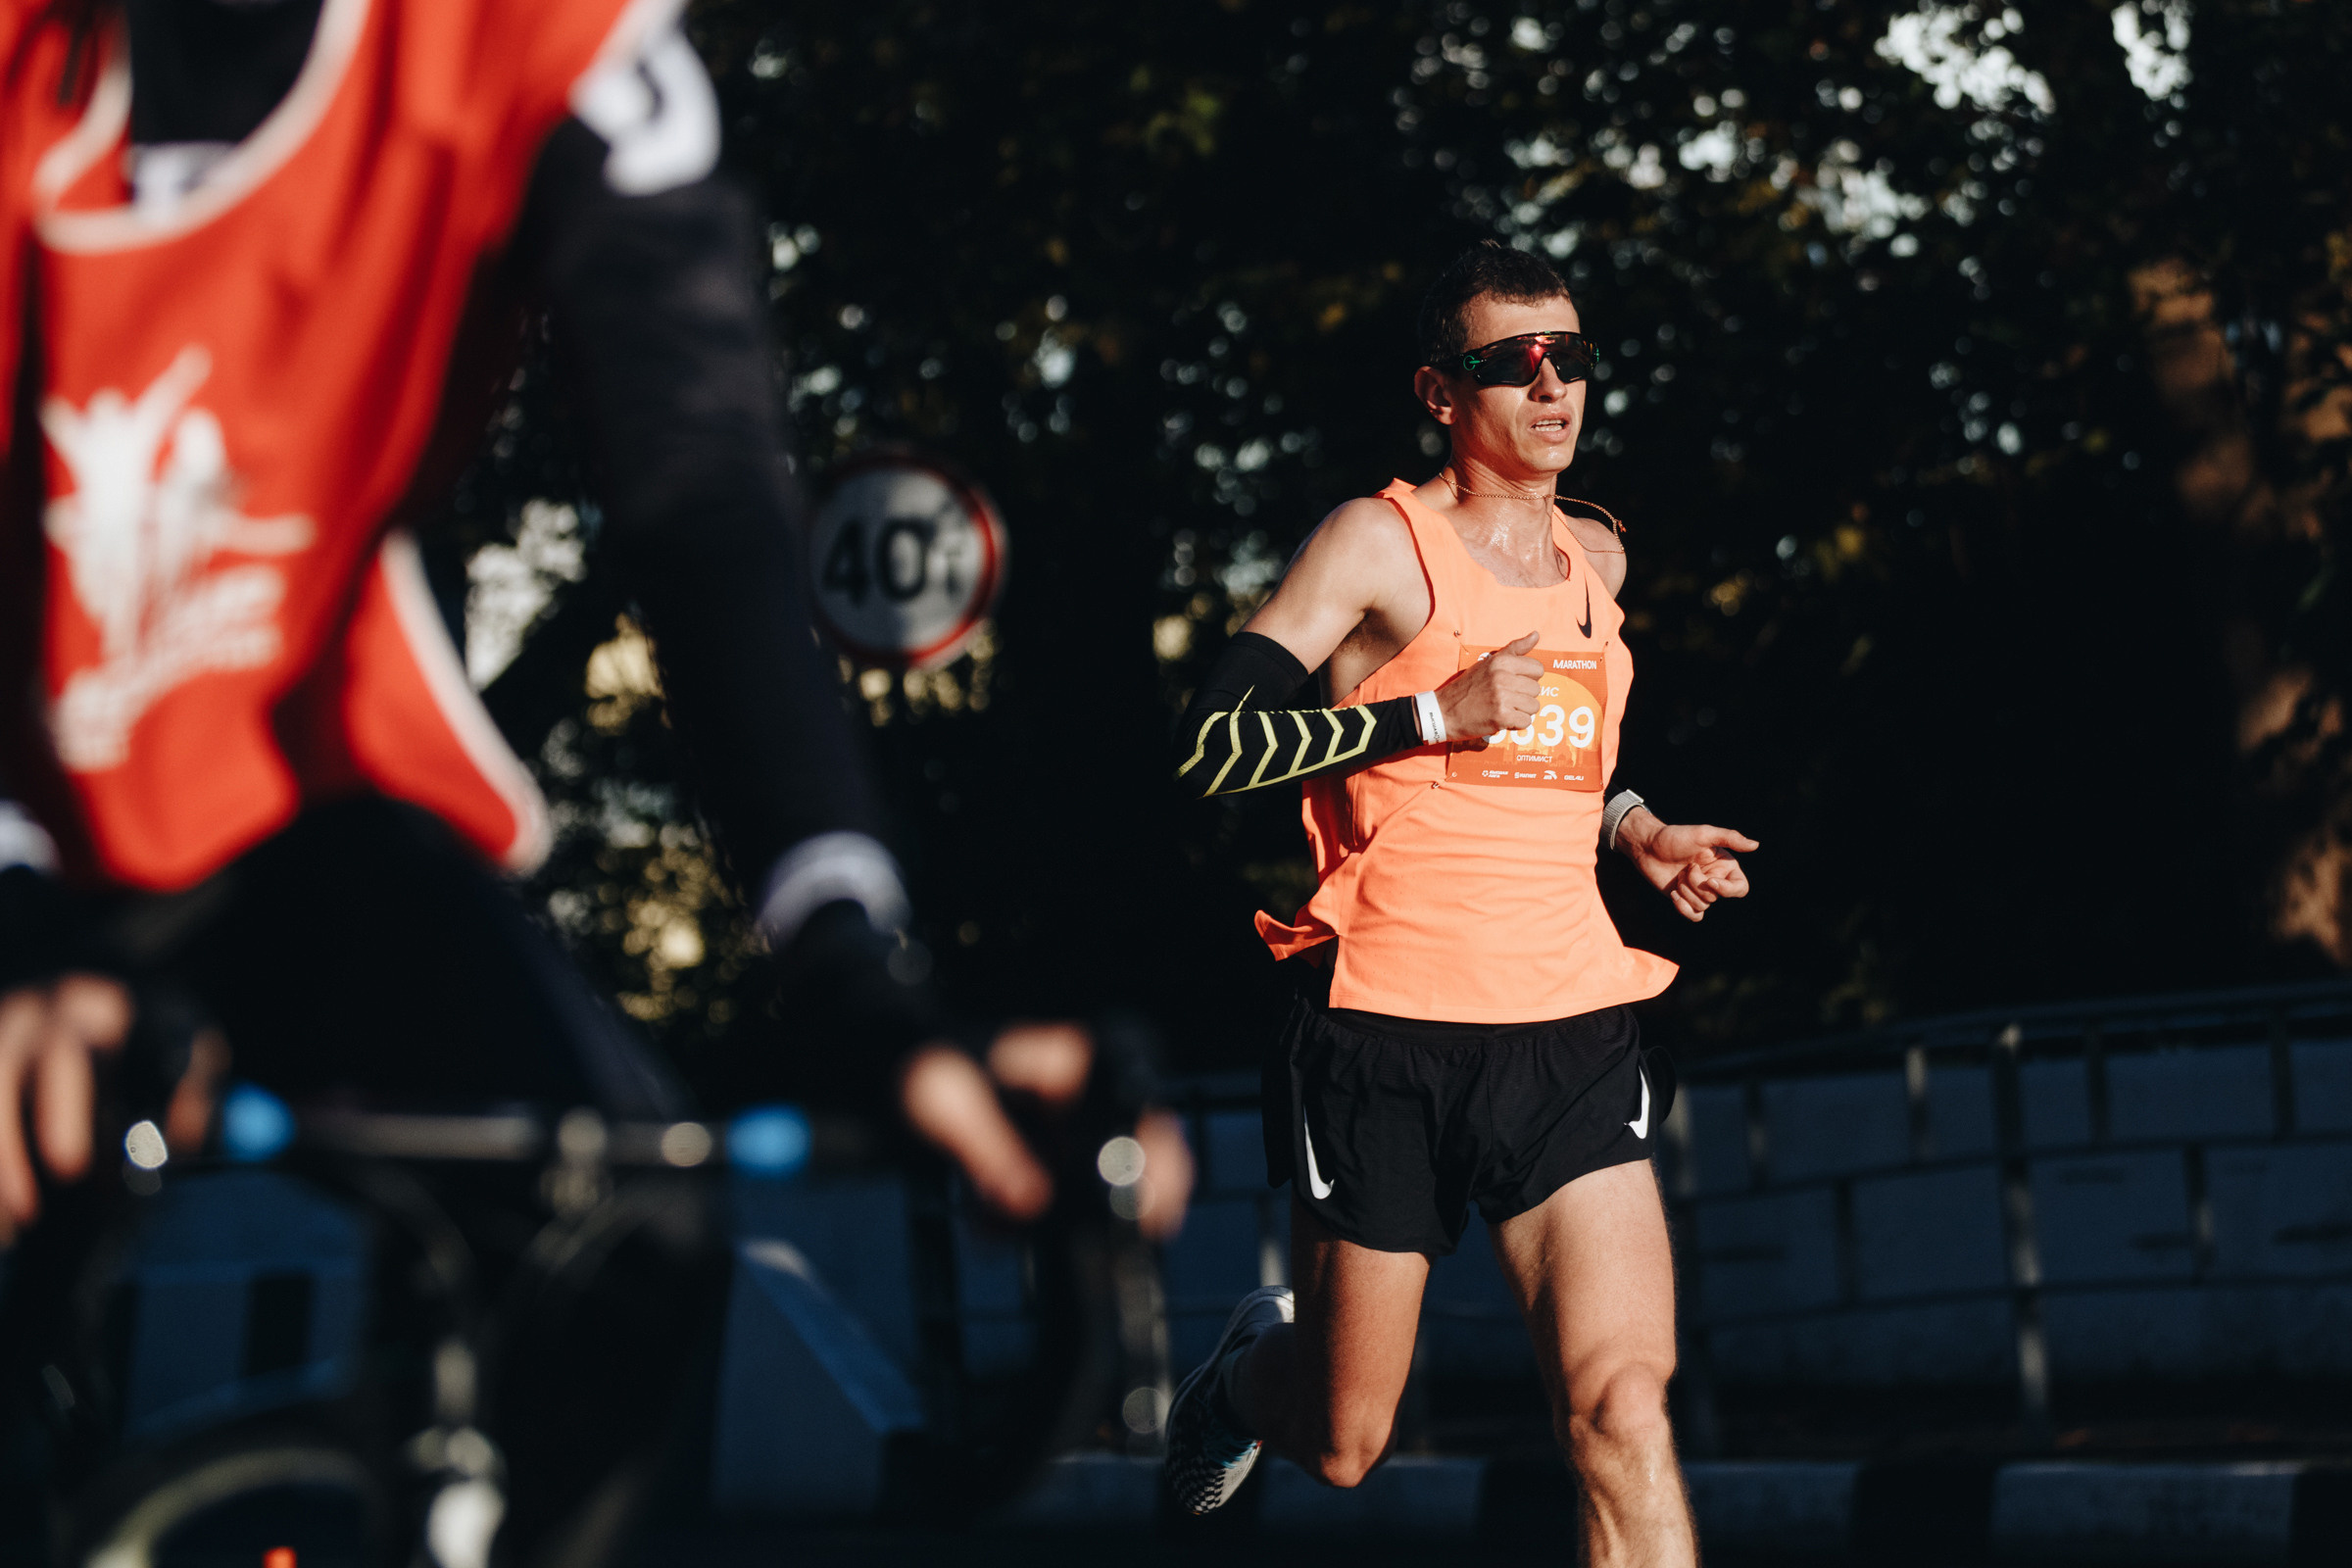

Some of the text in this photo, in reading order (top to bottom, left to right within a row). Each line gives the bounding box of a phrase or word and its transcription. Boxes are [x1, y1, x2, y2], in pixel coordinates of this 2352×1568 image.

[822, 516, 928, 606] 40
[1552, 659, 1597, 670] MARATHON
[1536, 685, 1560, 698] ИС
[1482, 704, 1595, 749] 39
[1516, 754, 1553, 763] ОПТИМИСТ
